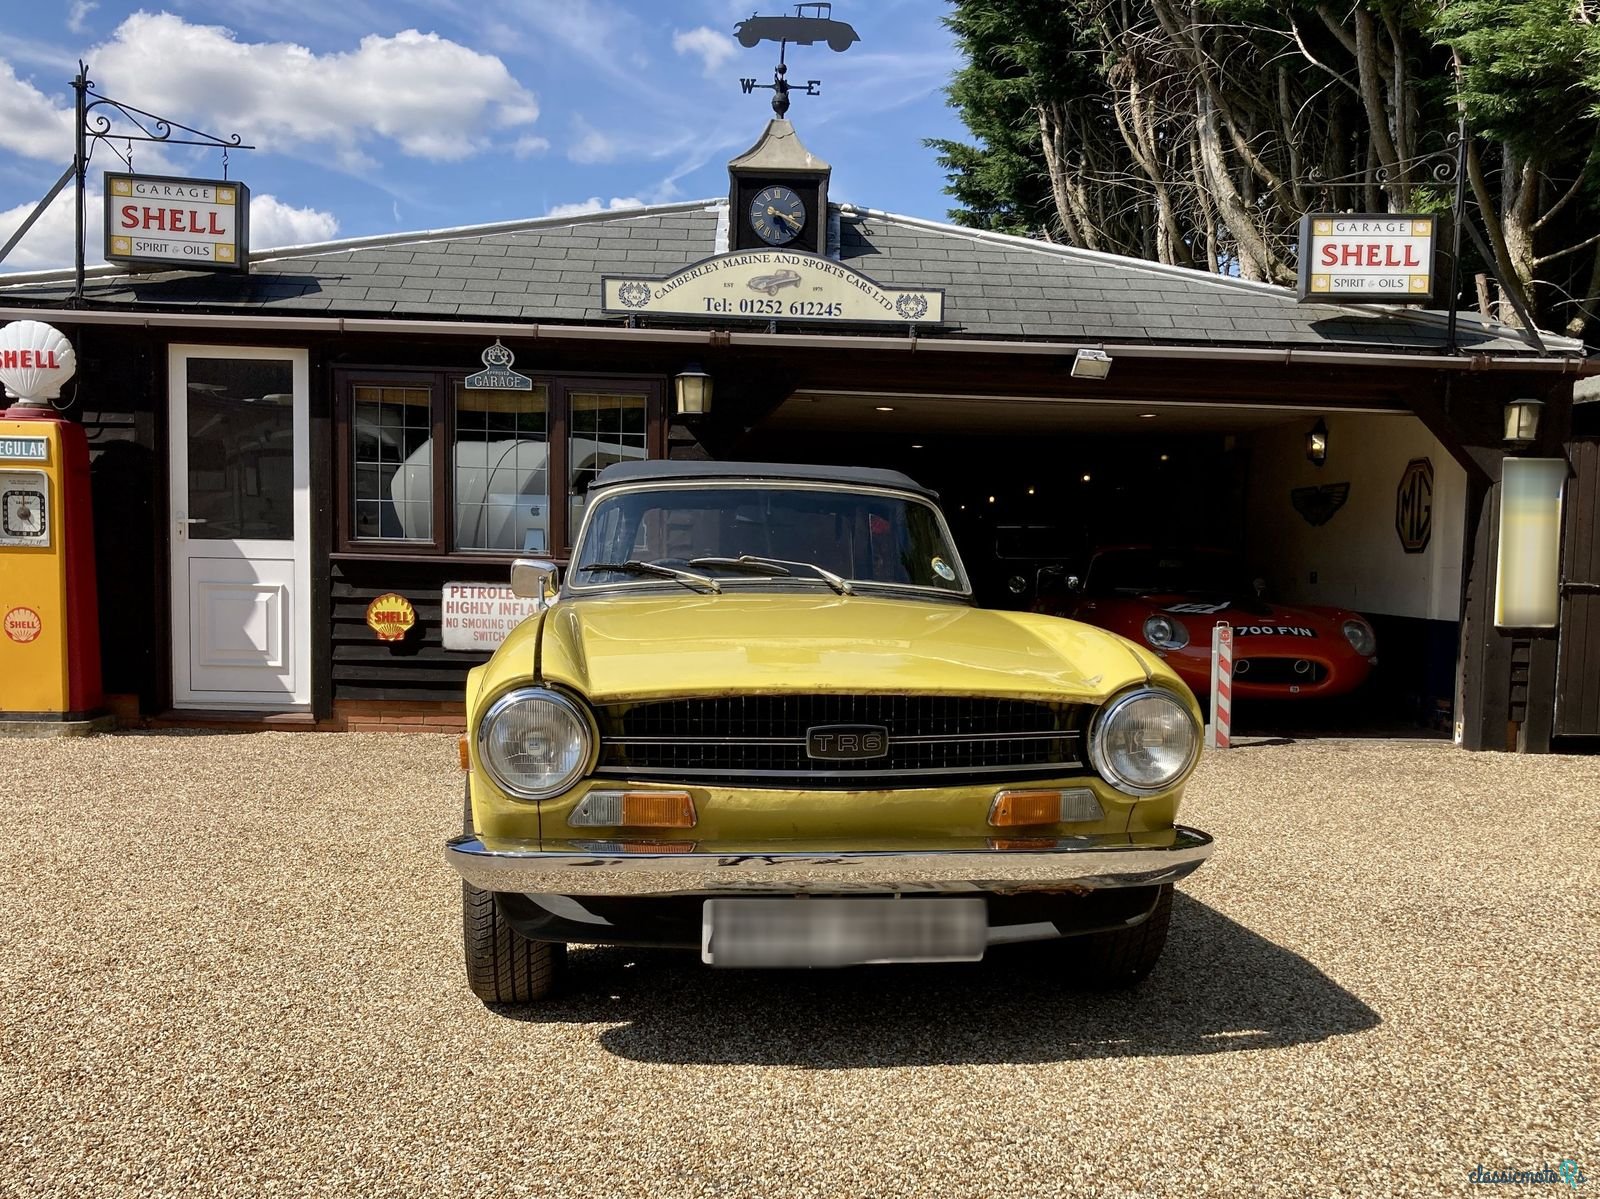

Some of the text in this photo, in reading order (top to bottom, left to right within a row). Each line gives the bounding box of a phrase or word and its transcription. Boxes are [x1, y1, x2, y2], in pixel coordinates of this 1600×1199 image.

[739, 78, 821, 95] W E
[136, 184, 210, 198] GARAGE
[121, 205, 226, 235] SHELL
[1336, 222, 1406, 232] GARAGE
[136, 242, 169, 253] SPIRIT
[183, 245, 210, 256] OILS
[1321, 243, 1420, 267] SHELL
[654, 254, 893, 311] CAMBERLEY MARINE AND SPORTS CARS LTD
[1334, 278, 1366, 288] SPIRIT
[1378, 278, 1404, 288] OILS
[703, 297, 843, 317] Tel: 01252 612245
[0, 350, 60, 369] HELL
[474, 376, 522, 388] GARAGE
[1401, 470, 1432, 541] MG
[446, 601, 540, 616] HIGHLY INFLA
[9, 620, 36, 629] SHELL
[374, 611, 410, 625] SHELL
[445, 617, 459, 628] NO
[462, 618, 504, 629] SMOKING
[473, 630, 505, 642] SWITCH
[1236, 626, 1312, 637] 700 FVN
[813, 734, 881, 752] TR6
